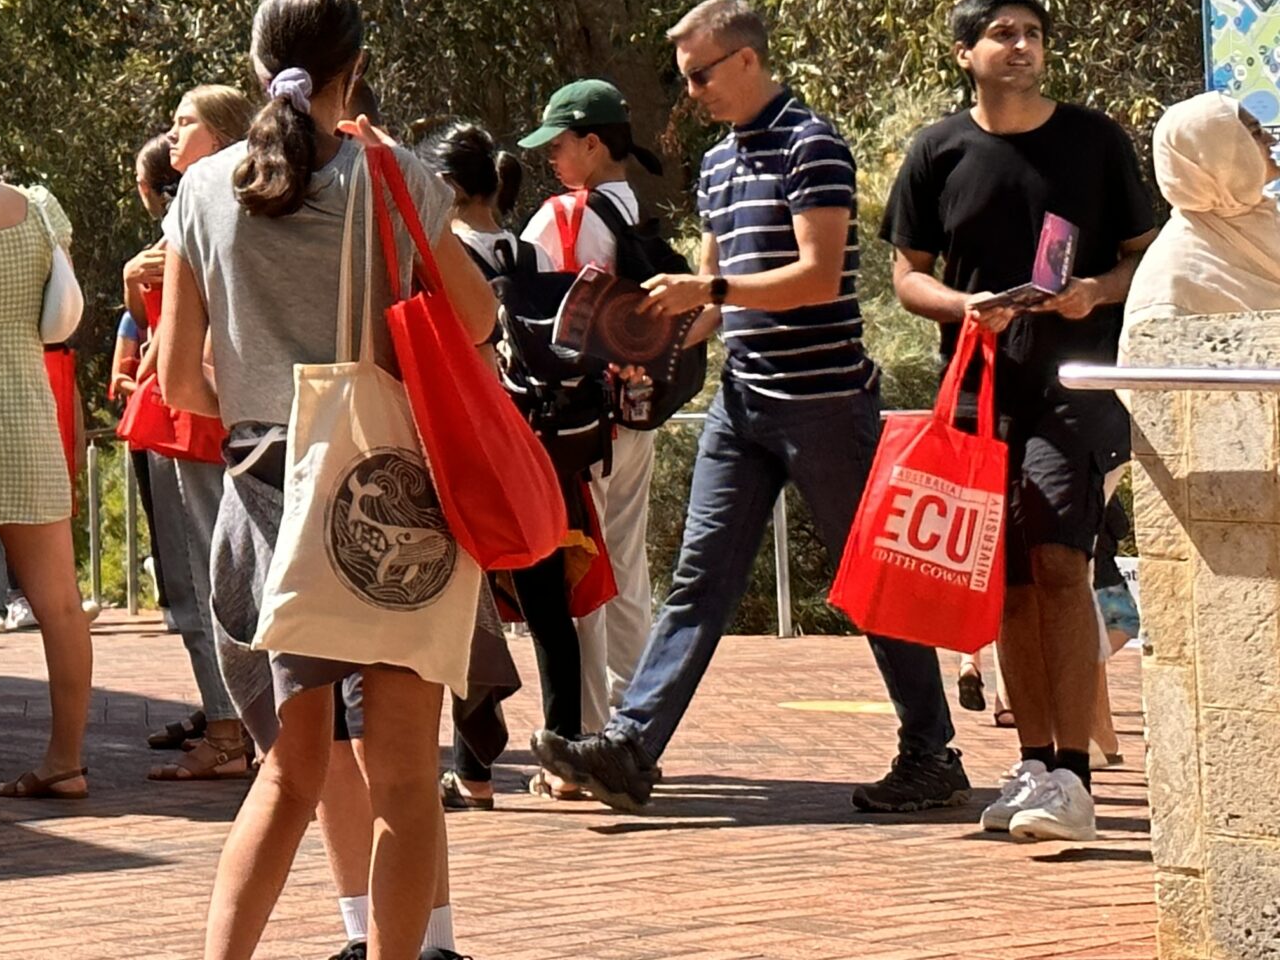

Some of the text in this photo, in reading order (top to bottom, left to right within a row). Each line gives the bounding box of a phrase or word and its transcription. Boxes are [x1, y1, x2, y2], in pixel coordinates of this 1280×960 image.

[897, 468, 957, 495] AUSTRALIA
[876, 486, 978, 564] ECU
[973, 497, 1001, 589] UNIVERSITY
